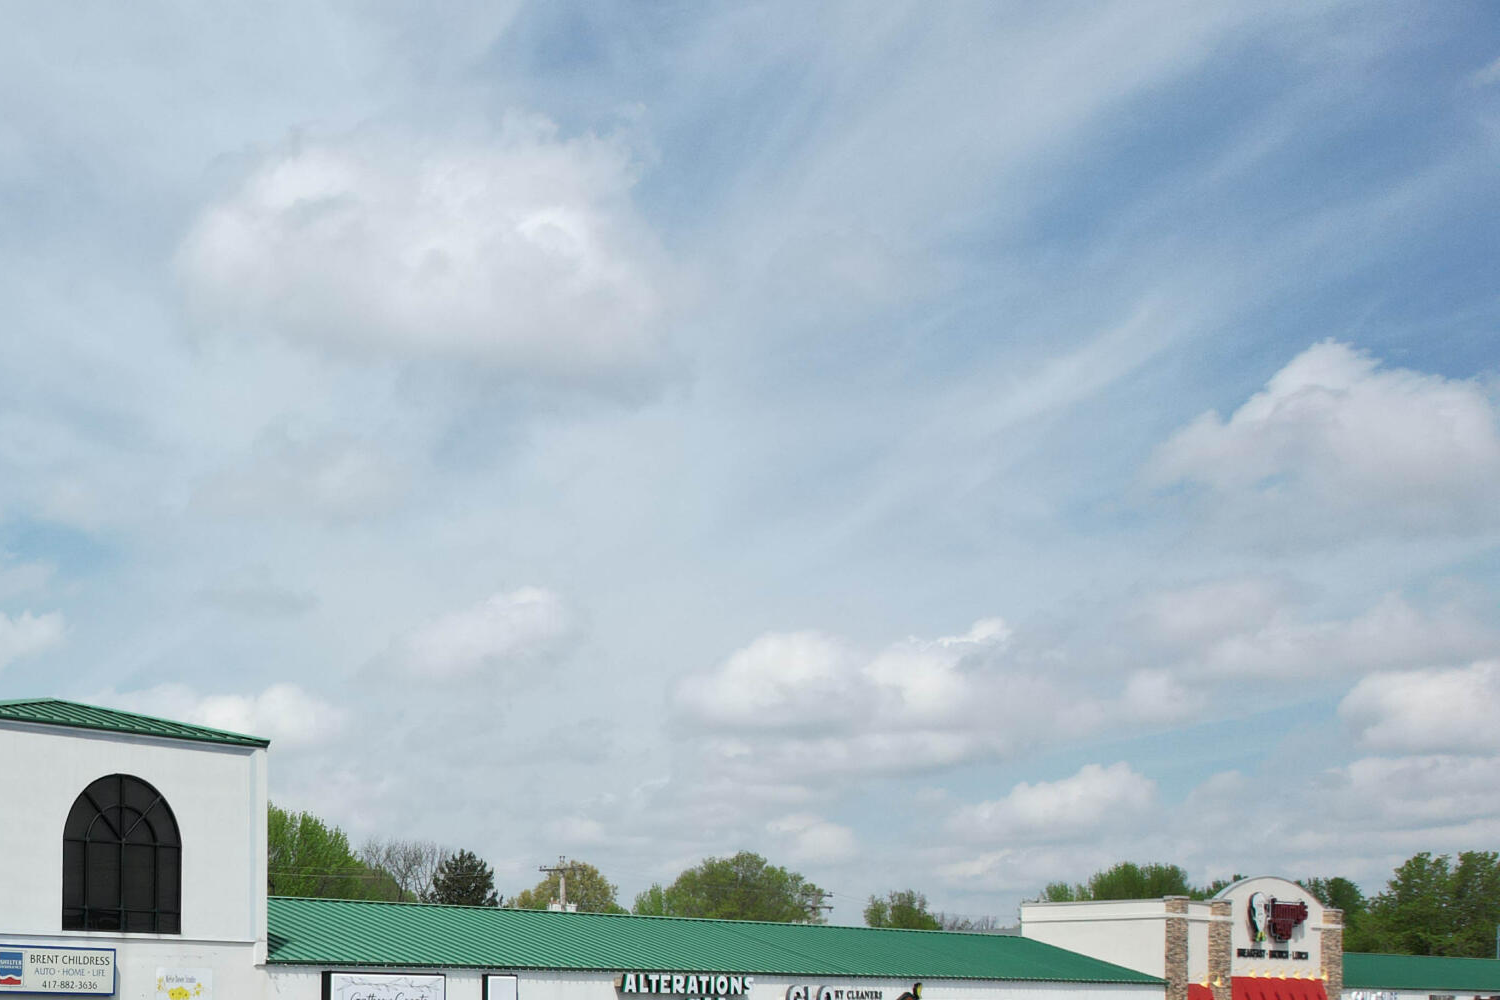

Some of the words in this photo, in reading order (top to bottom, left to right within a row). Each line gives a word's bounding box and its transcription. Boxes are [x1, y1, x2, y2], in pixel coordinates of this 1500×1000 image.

[30, 954, 59, 964] BRENT
[62, 955, 110, 965] CHILDRESS
[34, 967, 56, 976] AUTO
[62, 968, 86, 976] HOME
[92, 969, 106, 977] LIFE
[41, 980, 98, 990] 417-882-3636
[622, 973, 755, 995] ALTERATIONS
[834, 990, 844, 1000] RY
[846, 990, 883, 1000] CLEANERS
